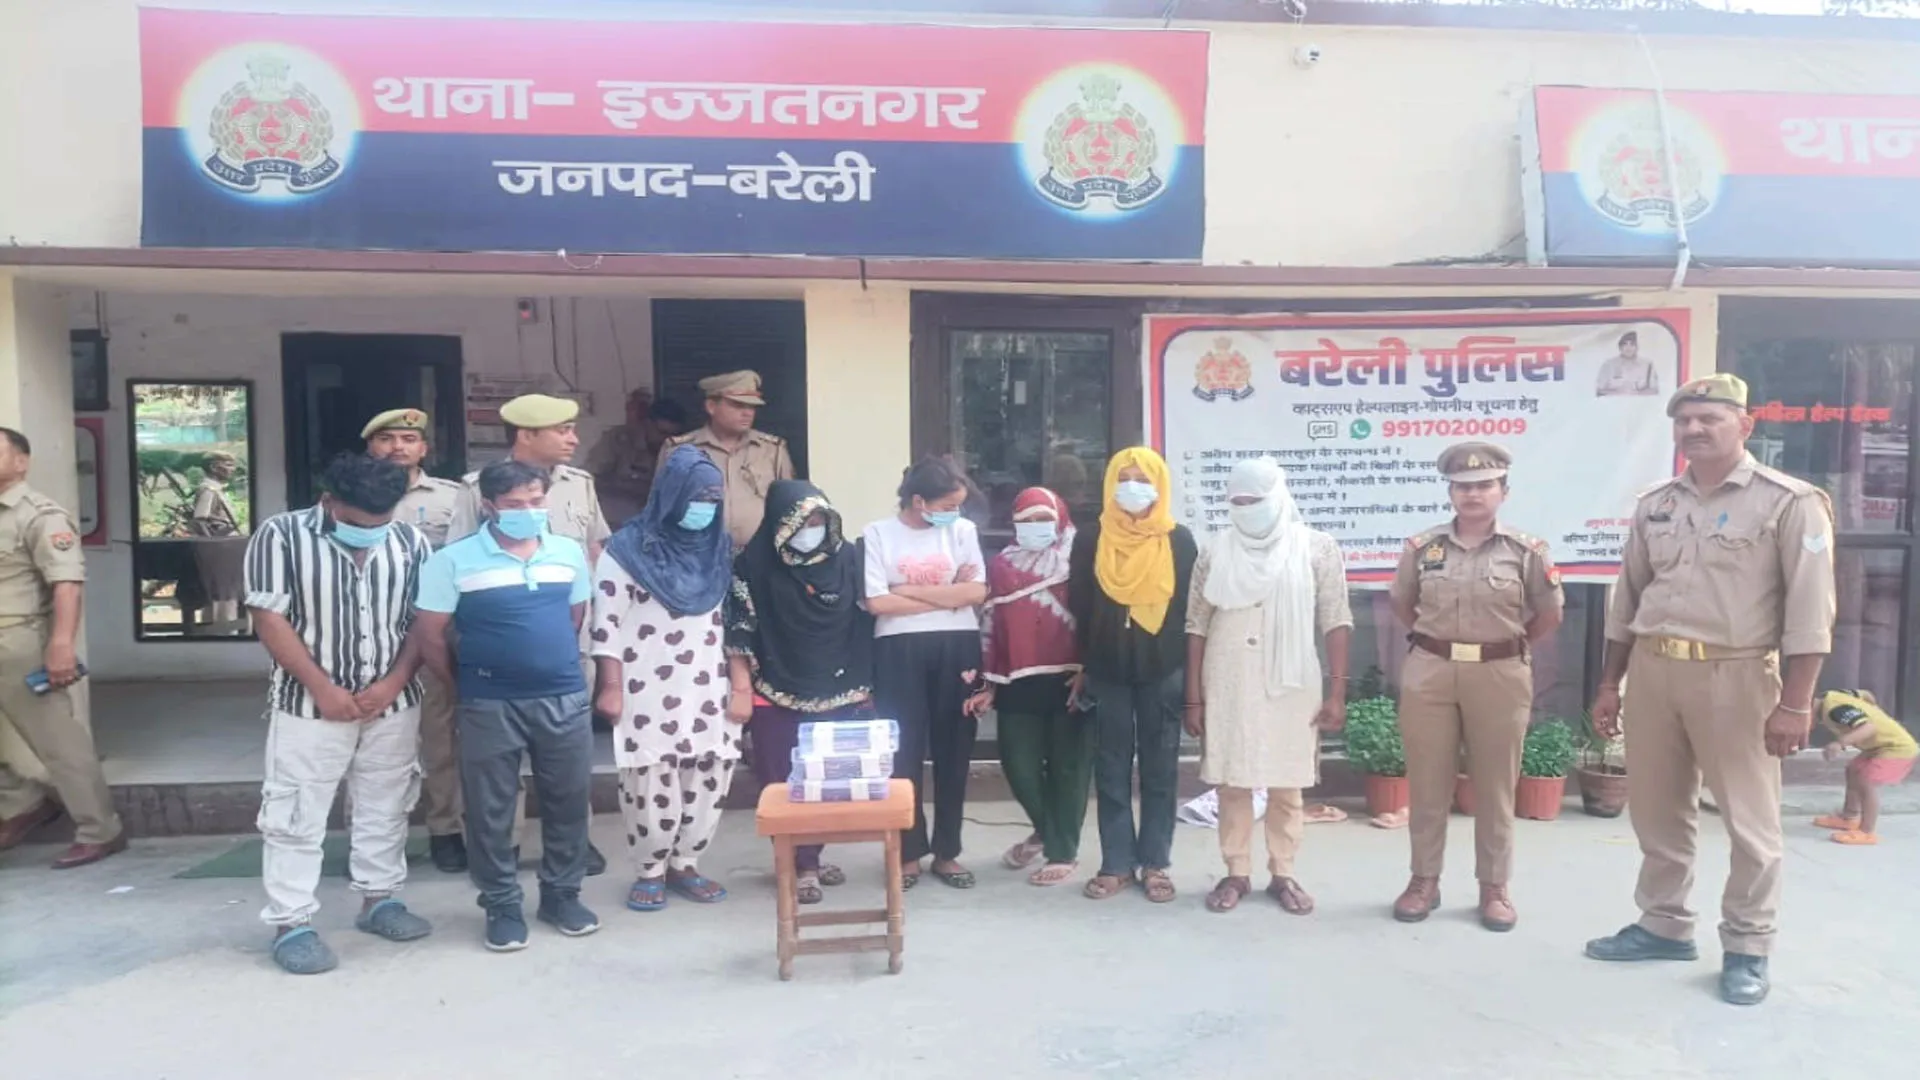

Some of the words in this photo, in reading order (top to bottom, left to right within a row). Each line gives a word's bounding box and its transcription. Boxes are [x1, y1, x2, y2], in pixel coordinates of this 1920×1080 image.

[596, 80, 987, 130] इज्जतनगर
[492, 150, 876, 203] जनपद-बरेली
[1274, 337, 1412, 387] बरेली
[1419, 335, 1570, 398] पुलिस
[1476, 399, 1516, 416] सूचना
[1519, 395, 1539, 414] हेतु
[1312, 424, 1334, 436] SMS
[1382, 418, 1527, 438] 9917020009
